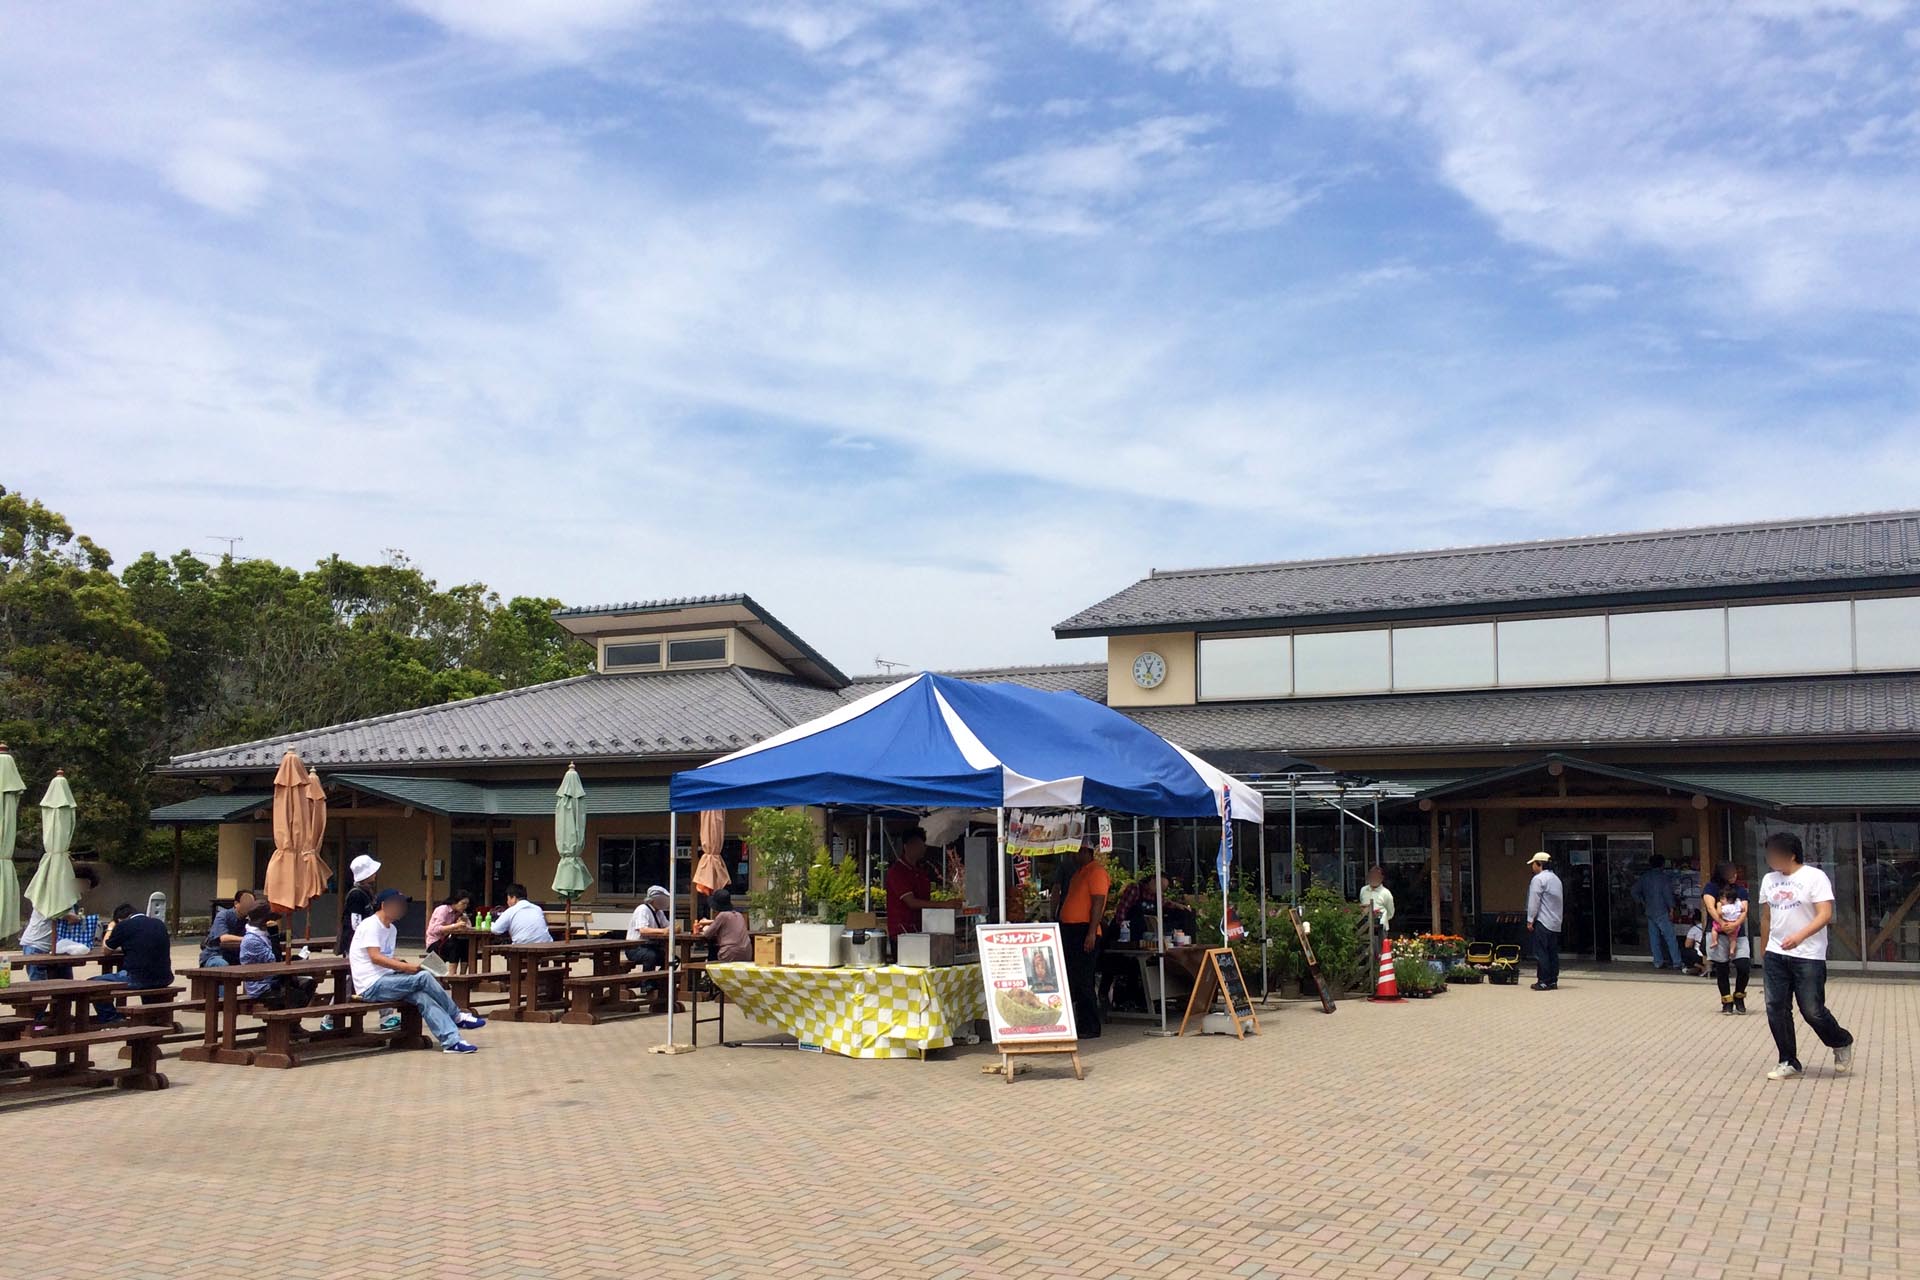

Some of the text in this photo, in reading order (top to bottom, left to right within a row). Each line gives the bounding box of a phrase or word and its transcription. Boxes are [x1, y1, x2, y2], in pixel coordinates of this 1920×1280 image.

[1101, 836, 1110, 848] 500
[992, 932, 1043, 944] ドネルケバブ
